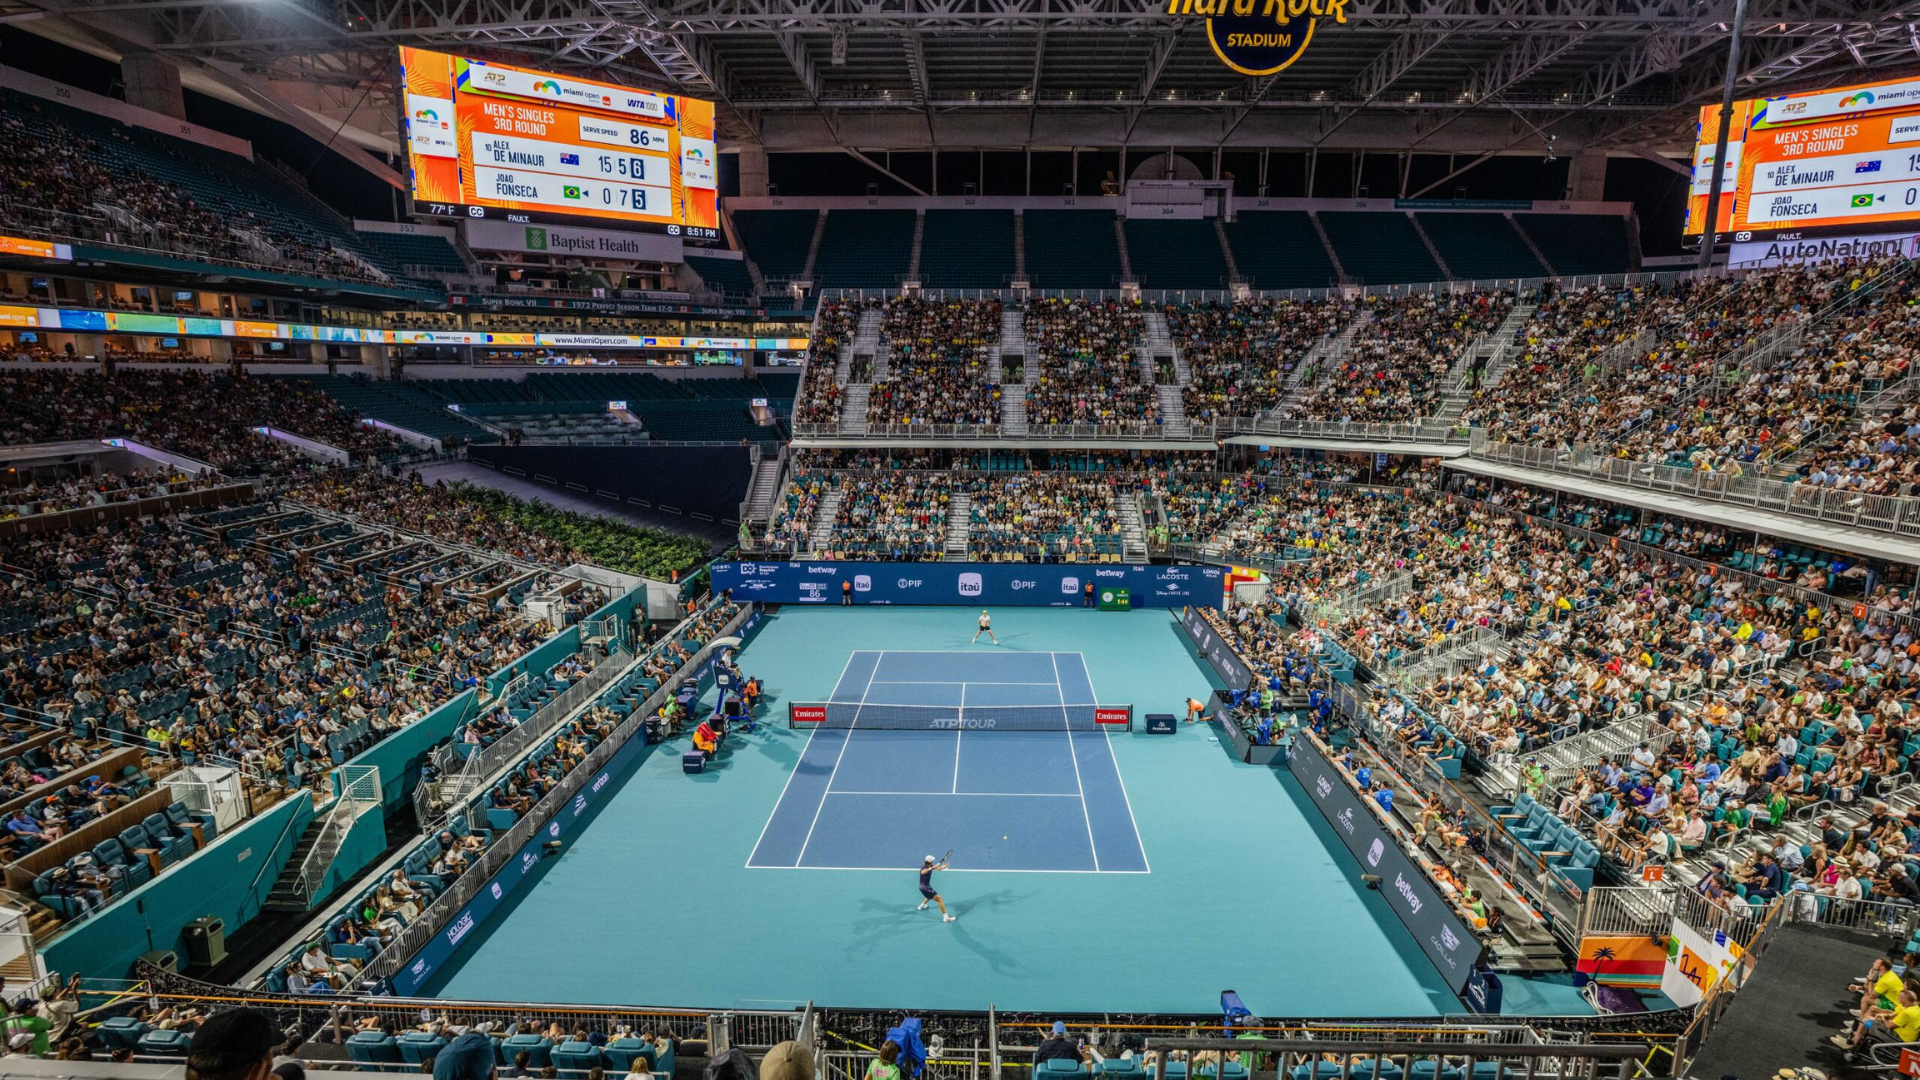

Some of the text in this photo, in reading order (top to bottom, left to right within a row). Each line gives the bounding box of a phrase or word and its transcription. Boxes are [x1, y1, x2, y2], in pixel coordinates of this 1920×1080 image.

[1227, 33, 1291, 47] STADIUM
[485, 72, 505, 81] ATP
[55, 86, 71, 98] 350
[563, 87, 600, 100] miami open
[1878, 90, 1905, 101] miami
[627, 98, 645, 109] WTA
[1783, 101, 1807, 112] ATP
[484, 102, 555, 124] MEN'S SINGLES
[180, 125, 191, 135] 351
[494, 117, 547, 136] 3RD ROUND
[1895, 125, 1920, 135] SERVE
[583, 125, 665, 146] SERVE SPEED 86 MPH
[1775, 124, 1859, 145] MEN'S SINGLES
[485, 143, 492, 151] 10
[493, 140, 510, 150] ALEX
[1782, 138, 1845, 156] 3RD ROUND
[494, 150, 545, 167] DE MINAUR
[598, 155, 612, 173] 15
[618, 158, 627, 175] 5
[633, 161, 641, 176] 6
[1776, 165, 1796, 175] ALEX
[496, 173, 514, 183] JOAO
[1767, 171, 1775, 179] 10
[1774, 170, 1835, 187] DE MINAUR
[496, 182, 538, 199] FONSECA
[603, 187, 611, 204] 0
[619, 189, 627, 206] 7
[634, 191, 643, 208] 5
[1772, 195, 1793, 206] JOAO
[1905, 187, 1917, 206] 0
[448, 205, 455, 215] F
[470, 206, 483, 217] CC
[1770, 203, 1818, 218] FONSECA
[508, 215, 530, 223] FAULT.
[399, 224, 415, 233] 352
[668, 225, 680, 235] CC
[687, 227, 716, 238] 8:51 PM
[1736, 232, 1750, 242] CC
[1777, 232, 1802, 241] FAULT.
[551, 233, 640, 254] Baptist Health
[1765, 236, 1898, 260] AutoNation
[482, 297, 502, 306] SUPER
[504, 298, 521, 307] BOWL
[572, 301, 590, 309] 1972
[617, 303, 637, 311] SEASON
[639, 304, 656, 312] TEAM
[701, 307, 717, 315] SUPER
[555, 336, 628, 346] www.MiamiOpen.com
[808, 566, 837, 575] betway
[1096, 569, 1125, 578] betway
[960, 582, 980, 591] itaú
[795, 709, 825, 718] Emirates
[1097, 711, 1127, 720] Emirates
[929, 719, 996, 729] ATP TOUR
[591, 772, 610, 793] verizon
[1337, 810, 1355, 835] LACOSTE
[1369, 847, 1380, 863] itaú
[521, 853, 539, 874] LACOSTE
[1649, 871, 1656, 879] L
[1394, 871, 1423, 915] betway
[446, 911, 472, 940] HOLOGIC
[1430, 935, 1457, 969] CADILLAC
[412, 964, 432, 985] CADILLAC
[381, 979, 386, 988] 2
[1481, 979, 1485, 988] 2
